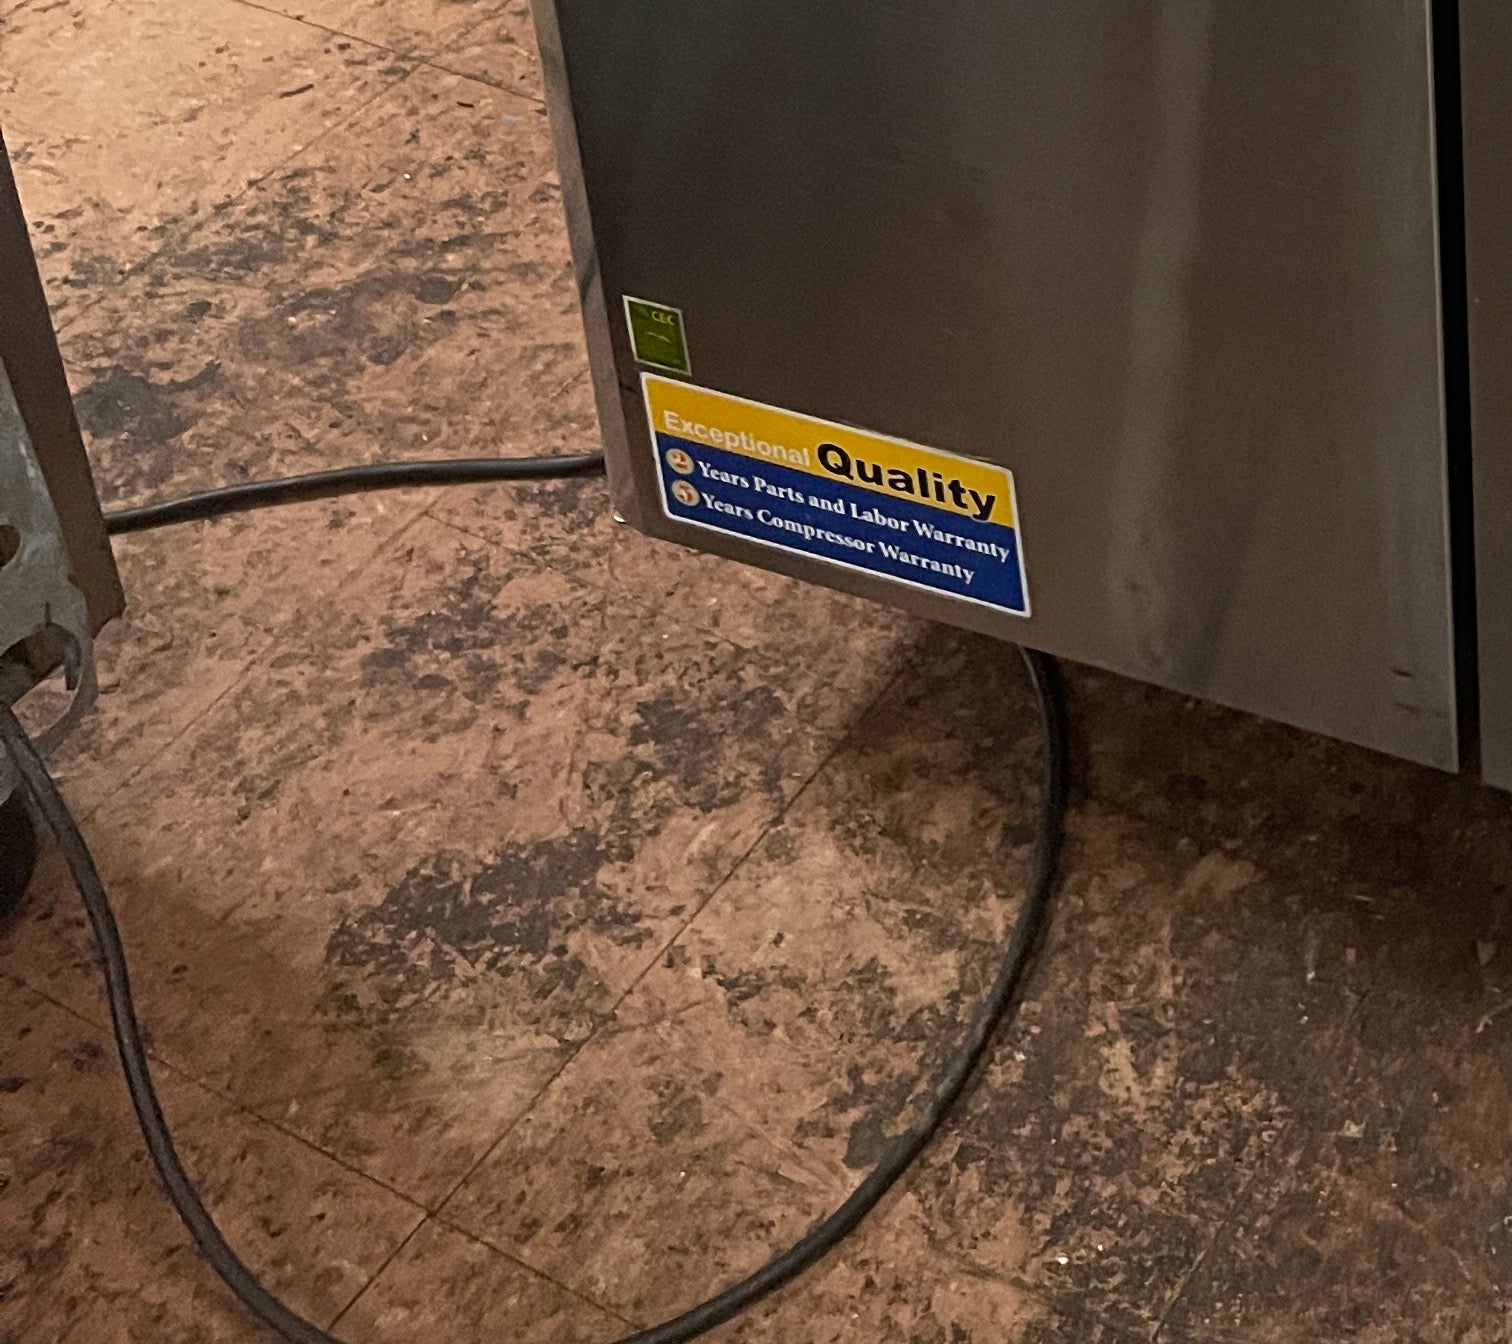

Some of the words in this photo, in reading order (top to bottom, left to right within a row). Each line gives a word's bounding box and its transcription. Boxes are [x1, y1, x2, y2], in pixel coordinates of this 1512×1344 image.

[651, 310, 676, 327] CEC
[664, 410, 810, 468] Exceptional
[817, 443, 997, 522] Quality
[698, 460, 749, 489] Years
[755, 476, 804, 505] Parts
[809, 491, 845, 515] and
[850, 503, 910, 534] Labor
[913, 519, 1010, 564] Warranty
[702, 492, 753, 522] Years
[758, 509, 876, 555] Compressor
[879, 541, 975, 584] Warranty
